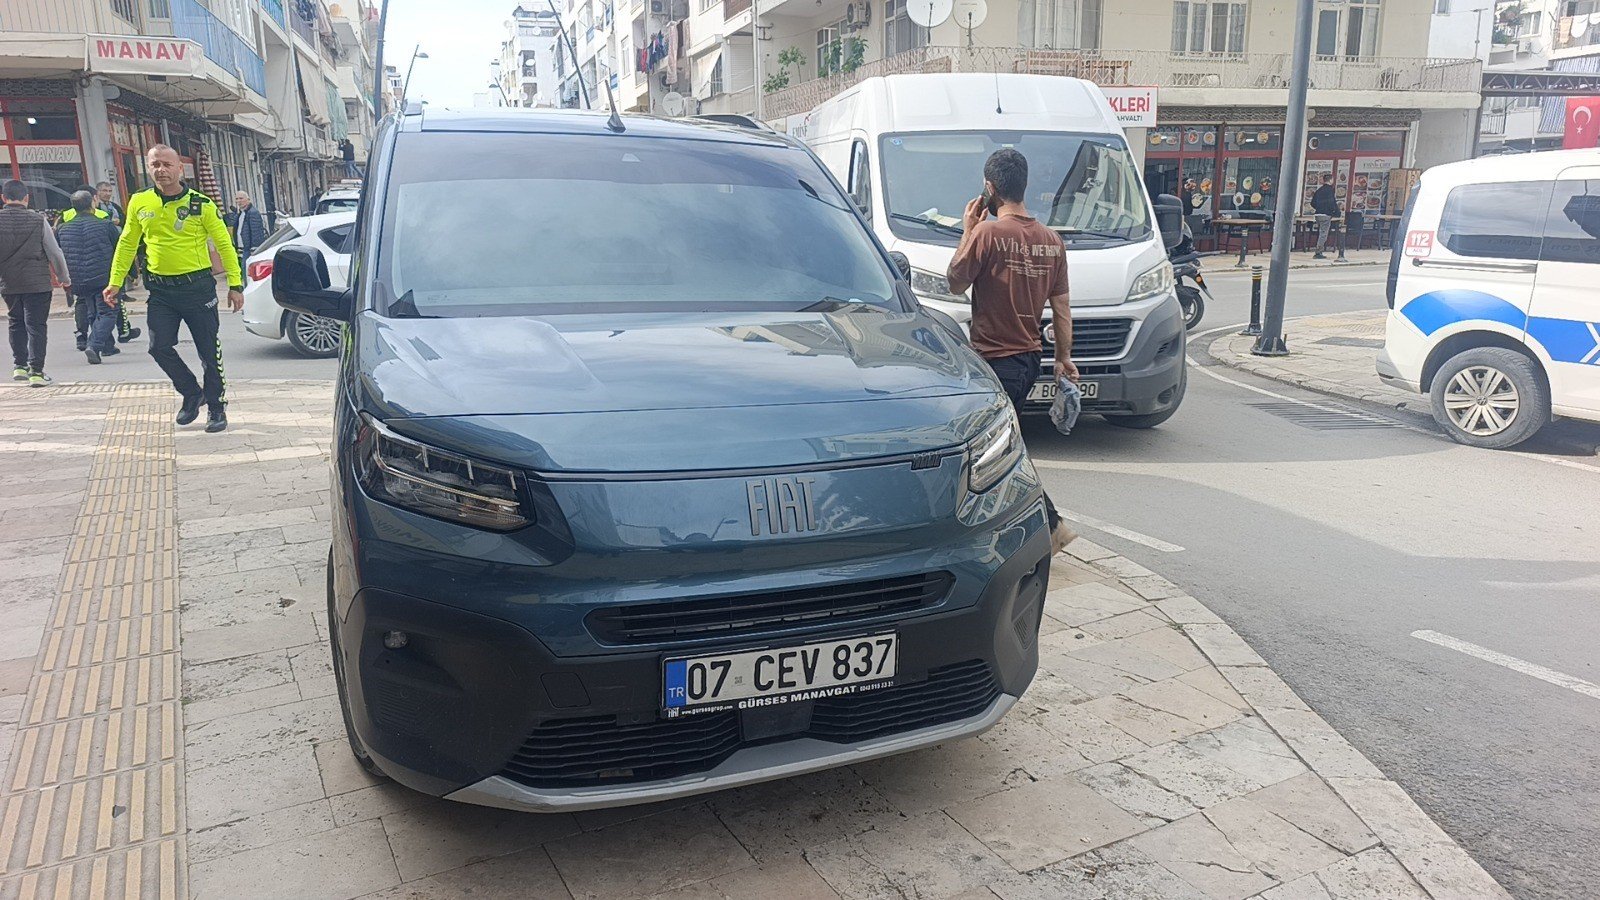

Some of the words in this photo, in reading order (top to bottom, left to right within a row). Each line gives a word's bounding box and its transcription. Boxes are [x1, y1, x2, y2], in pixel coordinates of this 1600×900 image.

[96, 40, 185, 60] MANAV
[1107, 92, 1150, 112] KLERİ
[22, 146, 74, 162] MANAV
[1411, 232, 1430, 246] 112
[745, 477, 816, 536] FIAT
[687, 660, 732, 700] 07
[754, 648, 821, 692] CEV
[832, 638, 893, 680] 837
[668, 686, 684, 698] TR
[738, 695, 788, 709] GÜRSES
[791, 685, 857, 702] MANAVGAT
